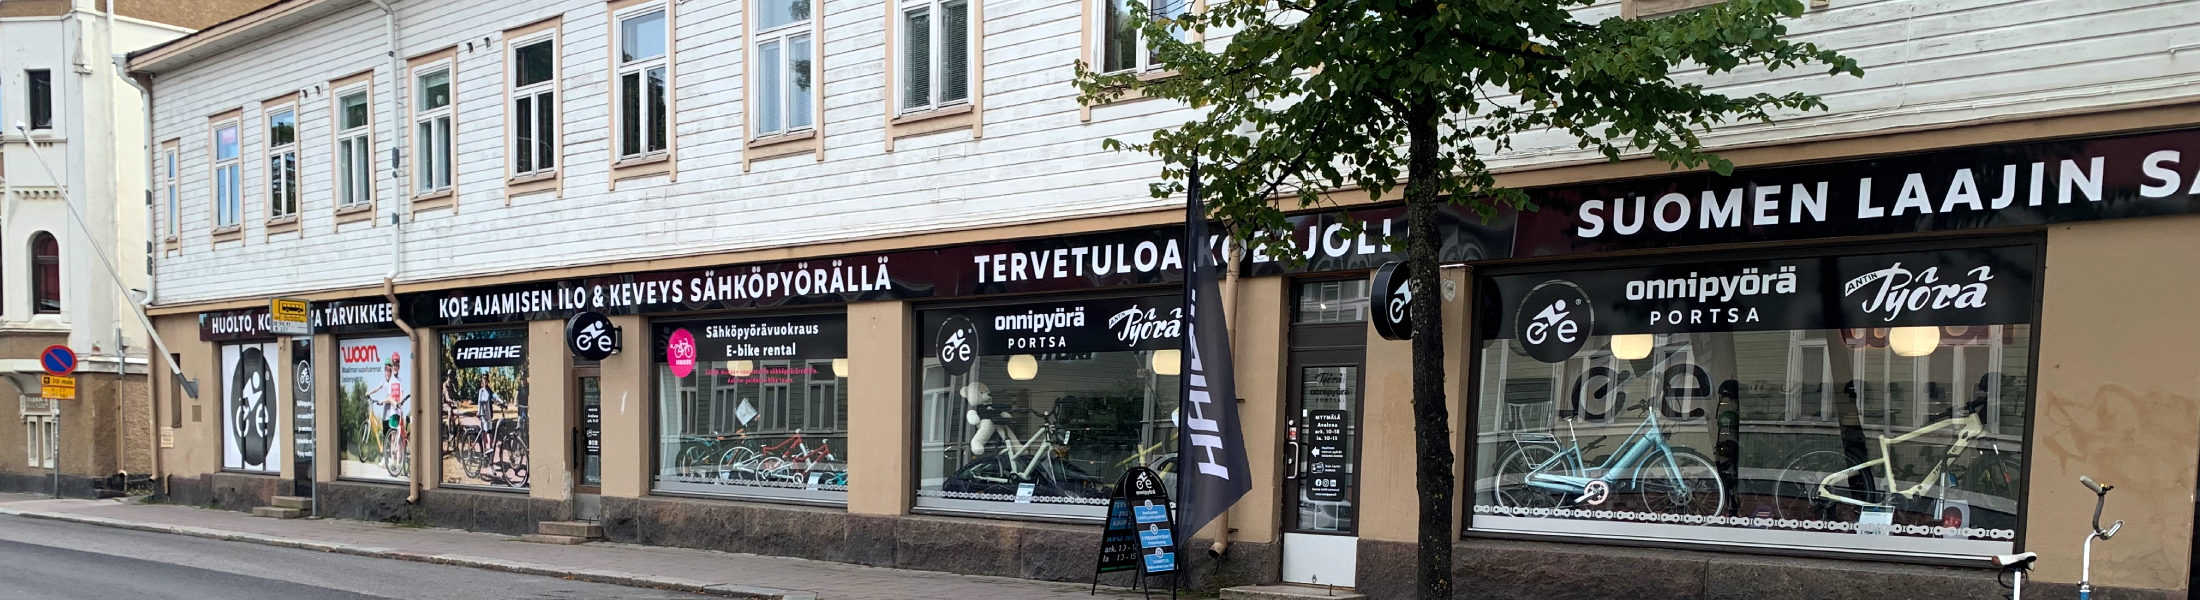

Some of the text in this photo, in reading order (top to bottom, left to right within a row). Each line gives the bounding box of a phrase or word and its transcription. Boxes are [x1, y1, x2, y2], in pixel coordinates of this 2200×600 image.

[1577, 150, 2200, 239] SUOMEN LAAJIN S
[974, 239, 1183, 283] TERVETULOA
[439, 256, 892, 318] KOE AJAMISEN ILO & KEVEYS SÄHKÖPYÖRÄLLÄ
[1626, 266, 1797, 303] onnipyörä
[1847, 272, 1878, 294] ANTIN
[1862, 262, 1994, 321] Pyörä
[212, 314, 255, 336] HUOLTO,
[311, 308, 323, 327] A
[325, 303, 393, 325] TARVIKKEE
[994, 307, 1085, 333] onnipyörä
[1117, 304, 1183, 347] Pyörä
[1650, 307, 1761, 326] PORTSA
[706, 322, 819, 340] Sähköpyörävuokraus
[1008, 336, 1067, 349] PORTSA
[341, 345, 381, 363] woom
[456, 345, 522, 360] HAIBIKE
[726, 342, 796, 357] E-bike rental
